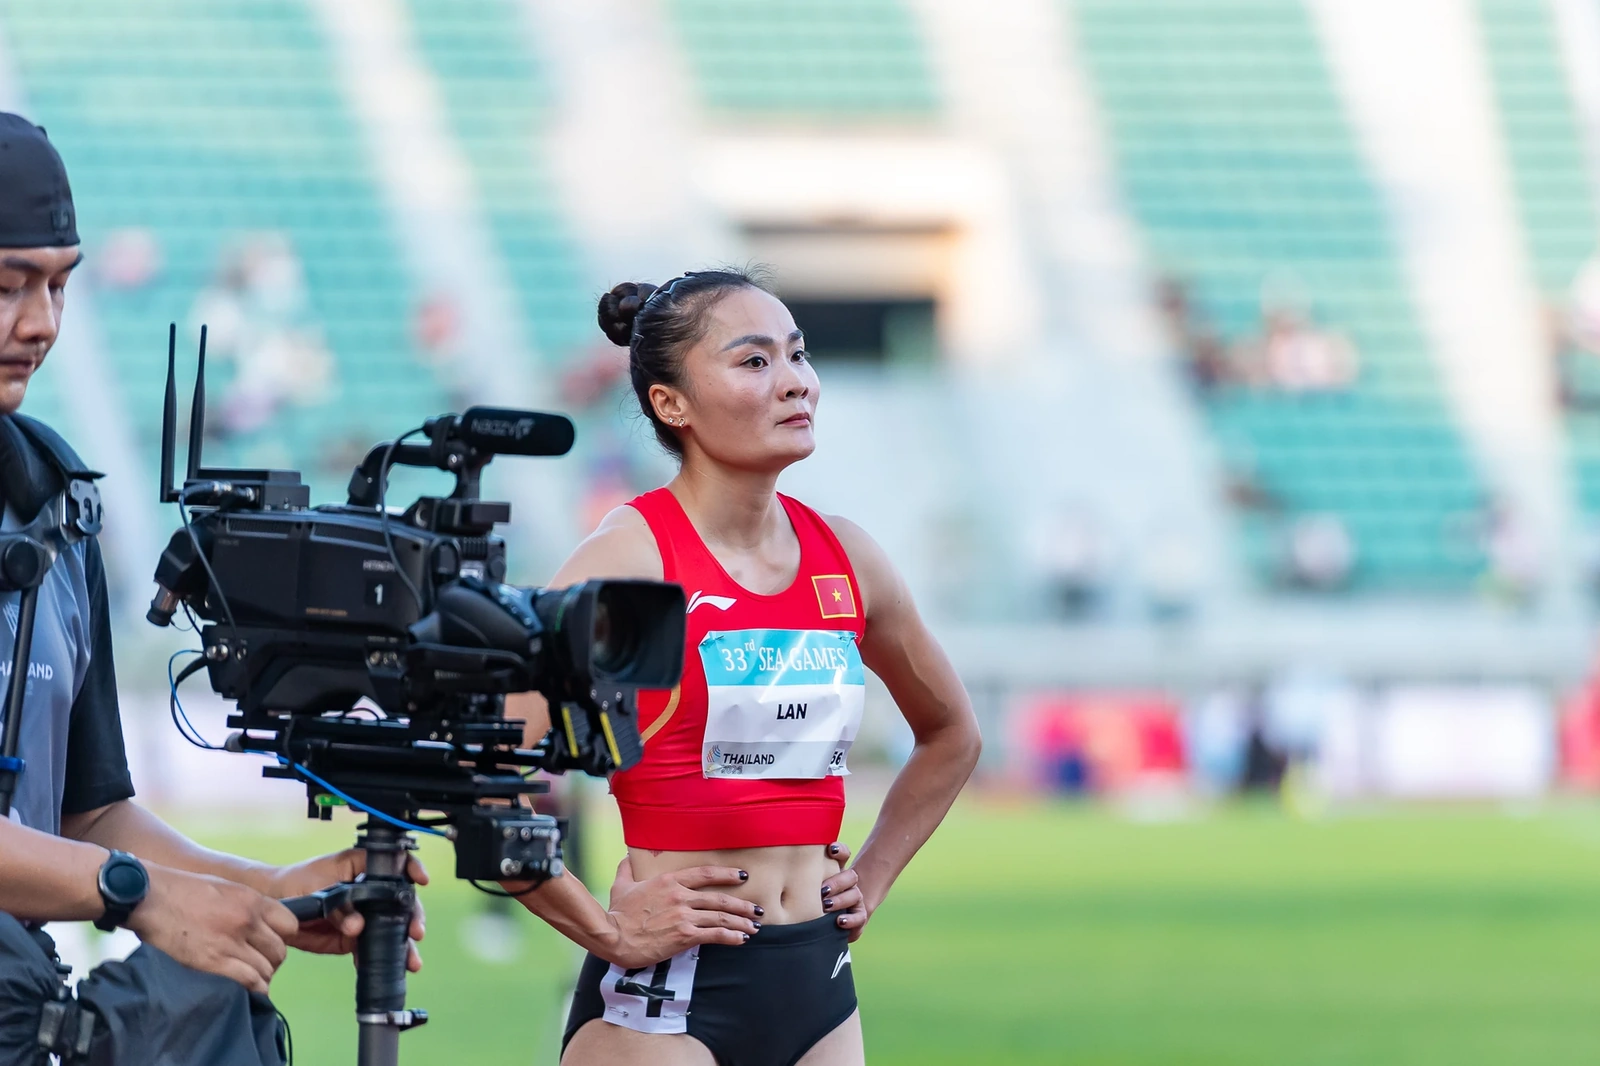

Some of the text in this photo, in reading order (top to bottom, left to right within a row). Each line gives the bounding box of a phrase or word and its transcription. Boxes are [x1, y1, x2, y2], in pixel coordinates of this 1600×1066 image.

[374, 583, 383, 606] 1
[721, 638, 848, 671] 33rd SEA GAMES
[776, 703, 808, 720] LAN
[723, 753, 775, 765] THAILAND
[614, 957, 676, 1018] 4
